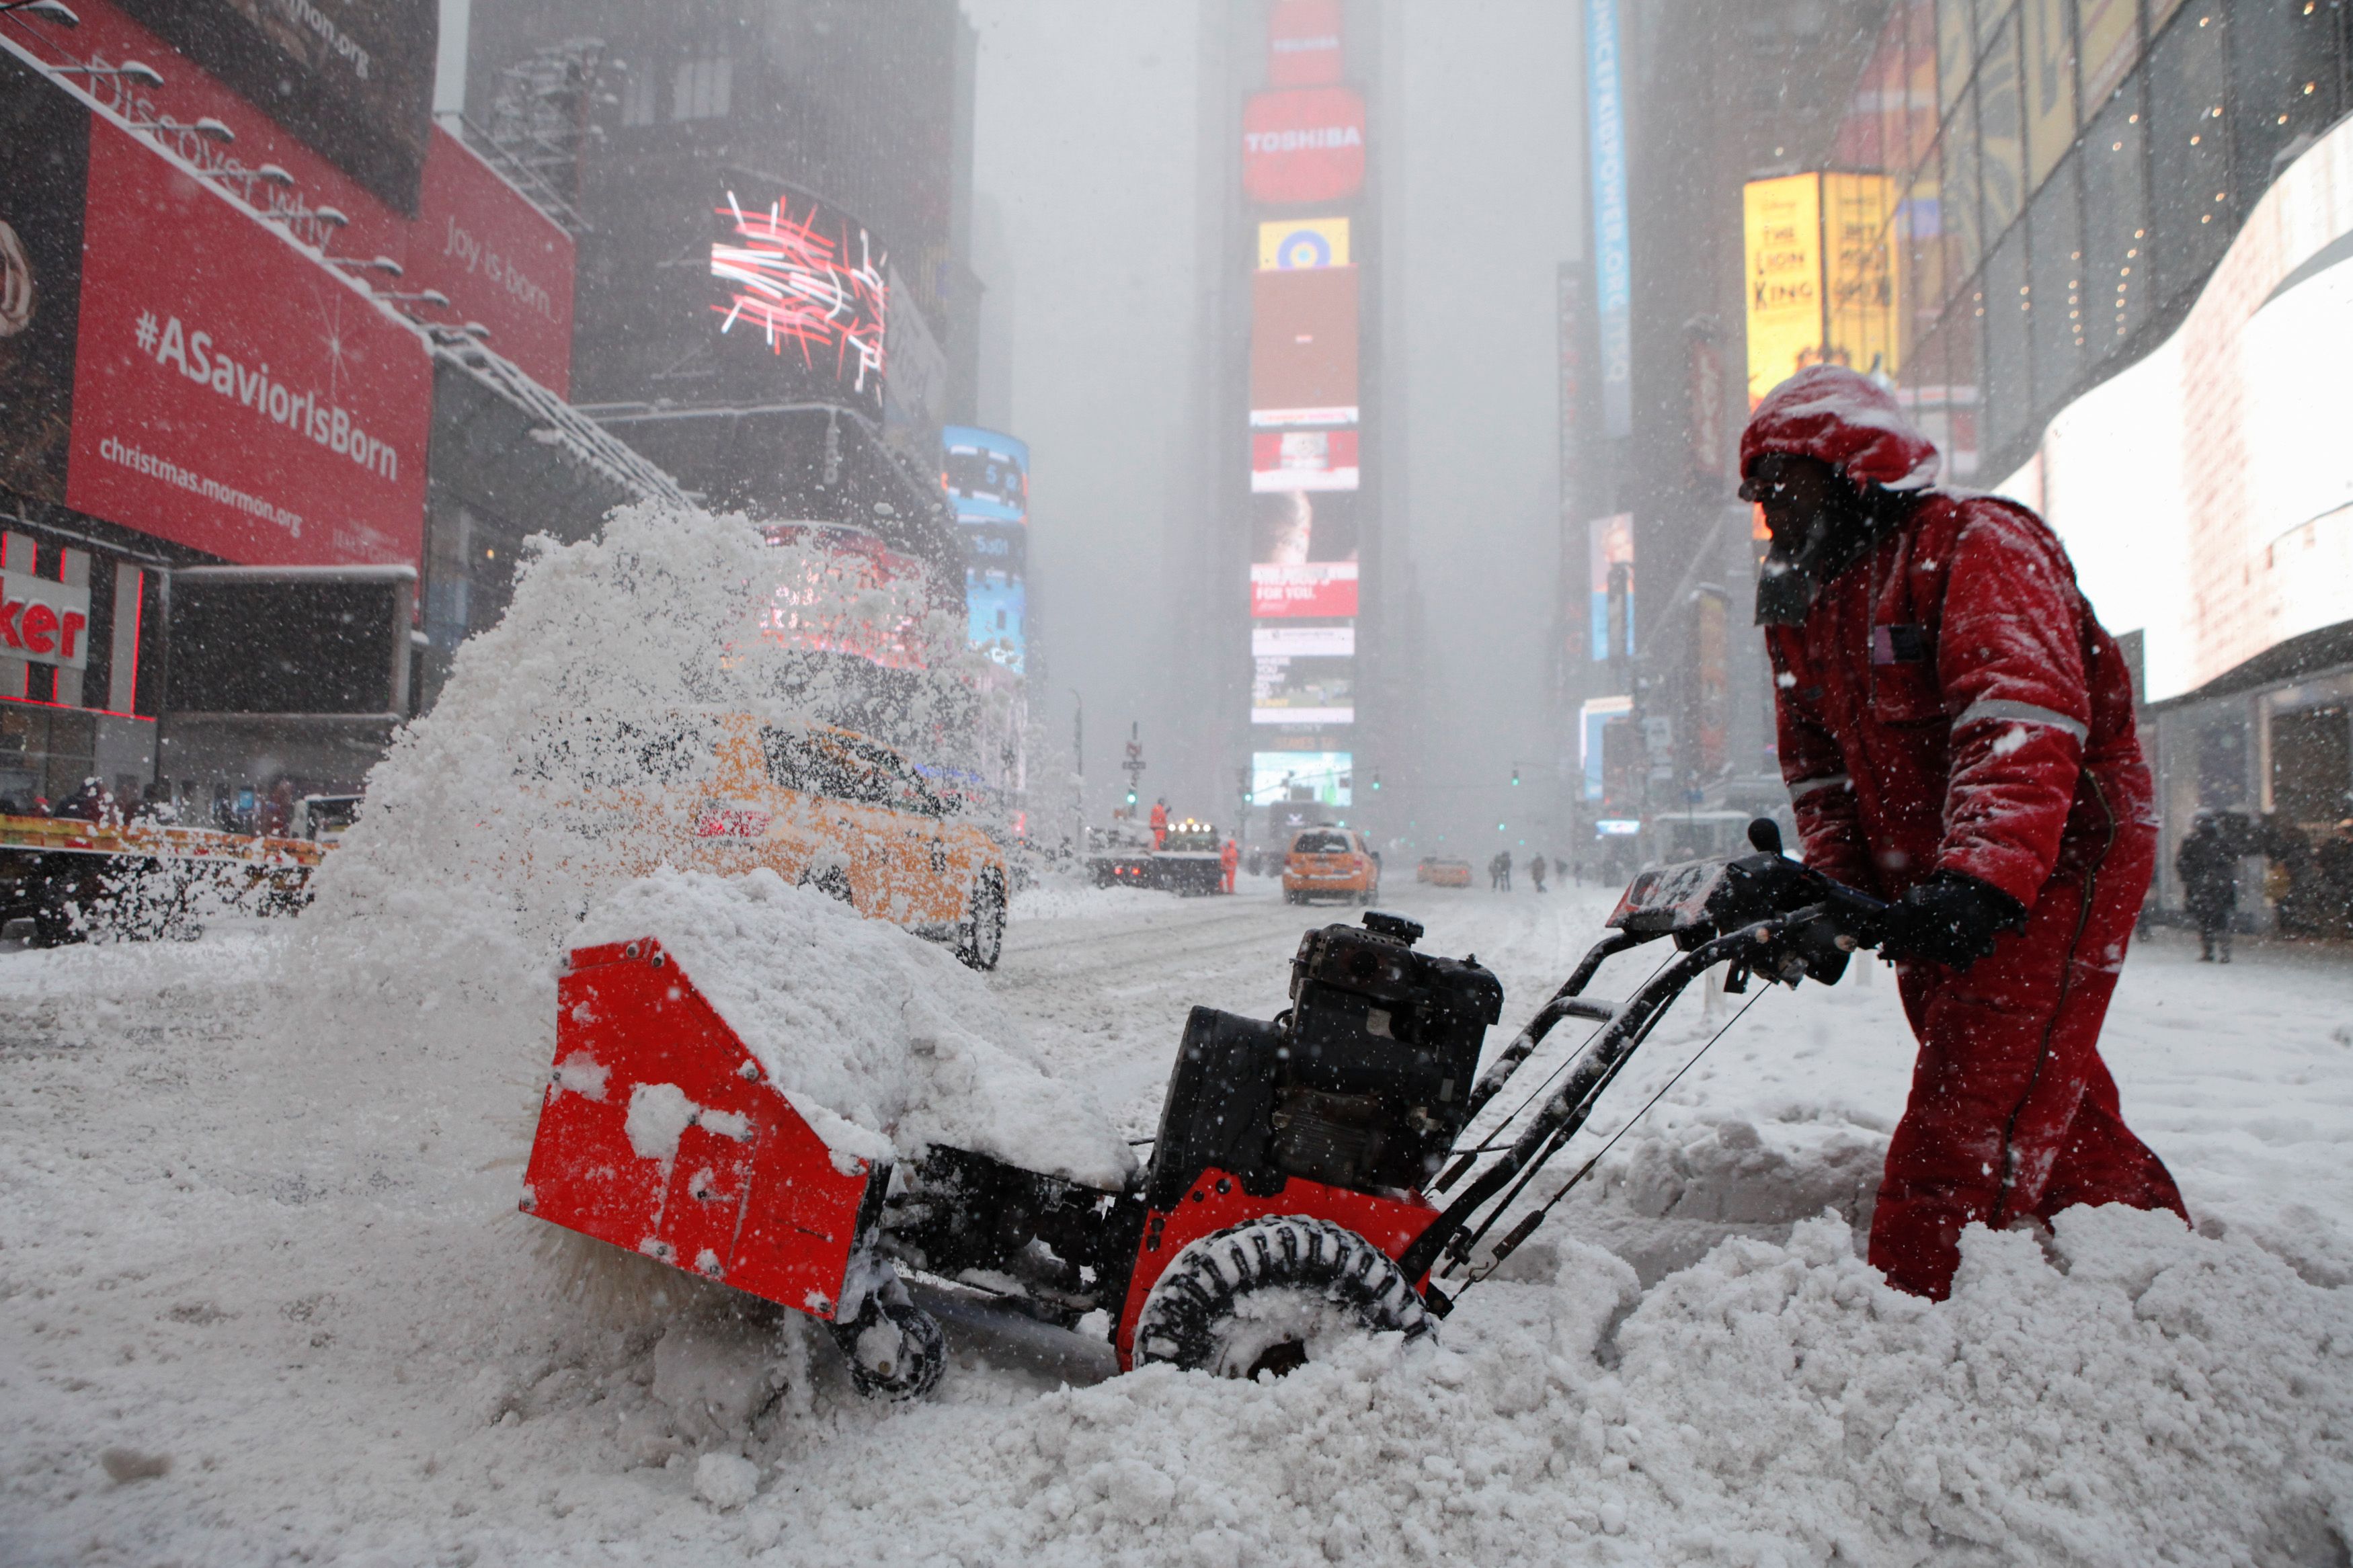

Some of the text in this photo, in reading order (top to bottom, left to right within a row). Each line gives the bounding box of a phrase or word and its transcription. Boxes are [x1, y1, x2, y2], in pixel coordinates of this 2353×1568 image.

[1244, 125, 1361, 153] TOSHIBA
[444, 215, 551, 319] Joy is born
[1754, 280, 1813, 311] KING
[136, 309, 399, 482] #ASaviorIsBorn
[99, 436, 303, 538] christmas.mormon.org
